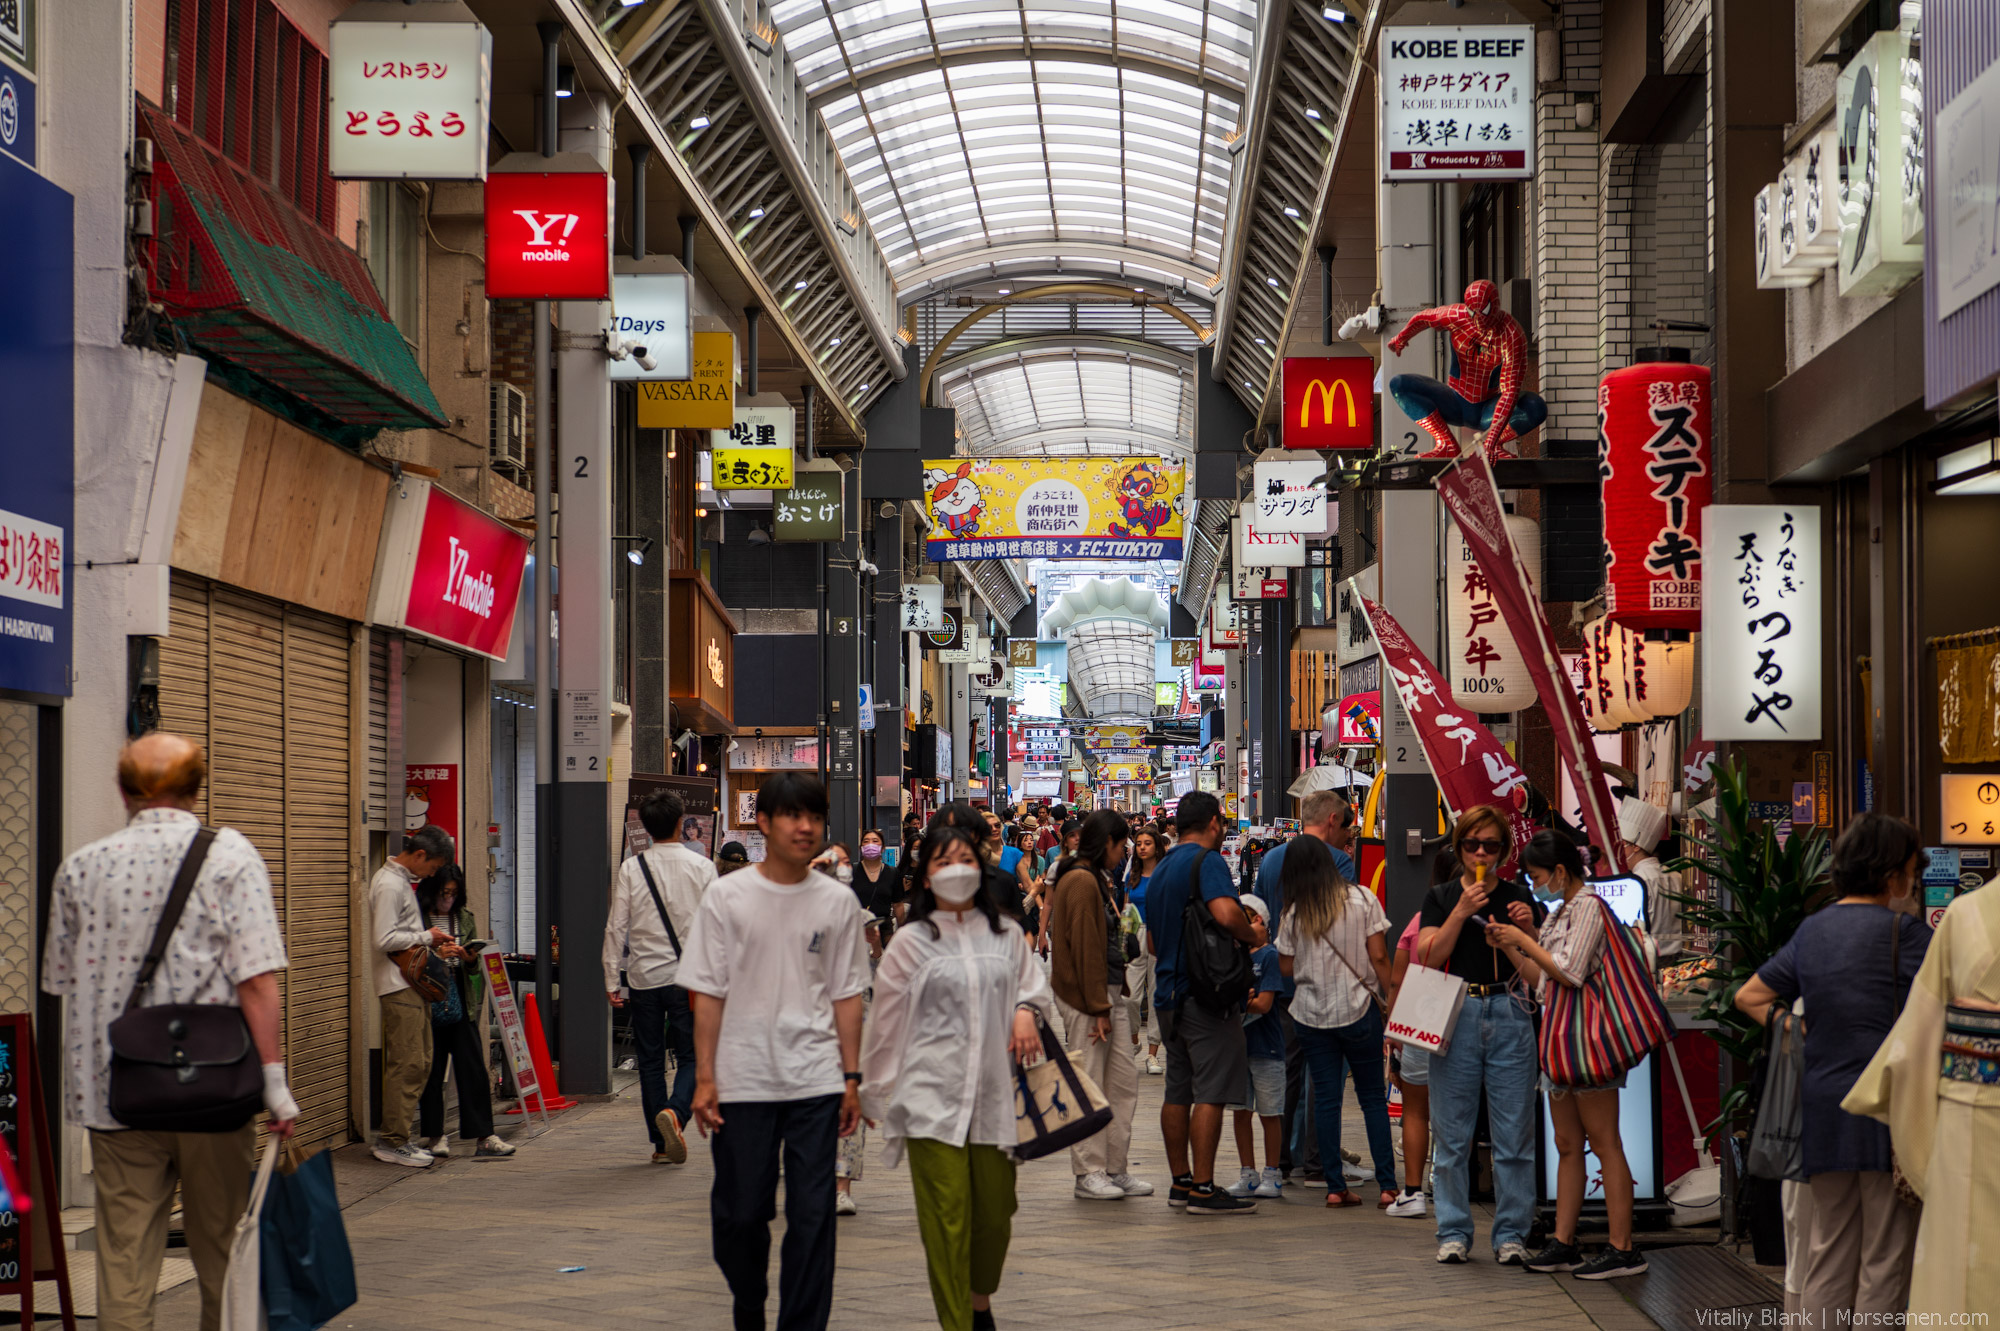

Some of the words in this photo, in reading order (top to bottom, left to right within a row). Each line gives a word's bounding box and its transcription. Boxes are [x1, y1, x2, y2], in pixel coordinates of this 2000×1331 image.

[1391, 40, 1458, 59] KOBE
[1464, 39, 1525, 58] BEEF
[363, 61, 448, 79] レストラン
[1399, 71, 1510, 93] 神戸牛ダイア
[1402, 100, 1437, 110] KOBE
[1441, 99, 1473, 109] BEEF
[1475, 98, 1507, 109] DAIA
[345, 110, 466, 137] とうよう
[1430, 155, 1466, 164] Produced
[1469, 155, 1480, 165] by
[513, 210, 579, 246] Y!
[522, 249, 570, 261] mobile
[699, 369, 725, 378] RENT
[642, 383, 729, 401] VASARA
[1650, 384, 1698, 404] 浅草
[1404, 432, 1418, 455] 2
[573, 456, 589, 479] 2
[1648, 407, 1703, 580] ステーキ
[777, 502, 840, 522] おこげ
[1027, 504, 1079, 518] 新仲見世
[1259, 493, 1322, 517] サワダ
[1027, 519, 1079, 531] 商店街へ
[1246, 524, 1299, 545] KEN
[1077, 540, 1164, 558] F.C.TOKYO
[1777, 512, 1804, 598] うなぎ
[1734, 533, 1764, 610] 天ぷら
[459, 571, 495, 619] mobile
[1653, 582, 1700, 594] KOBE
[1653, 597, 1700, 609] BEEF
[4, 616, 55, 643] HARIKYUIN
[838, 620, 848, 633] 3
[1462, 565, 1502, 677] 神戸牛
[1013, 642, 1033, 661] 新
[1175, 641, 1195, 661] 新
[1744, 611, 1793, 733] つるや
[1231, 681, 1237, 689] 5
[1462, 677, 1505, 694] 100%
[957, 691, 963, 699] 5
[998, 724, 1003, 732] 6
[588, 756, 598, 771] 2
[1396, 747, 1407, 762] 2
[846, 763, 852, 771] 3
[1253, 770, 1259, 779] 4
[1594, 884, 1628, 898] BEEF
[1388, 1021, 1417, 1037] WHY
[1416, 1031, 1441, 1045] AND
